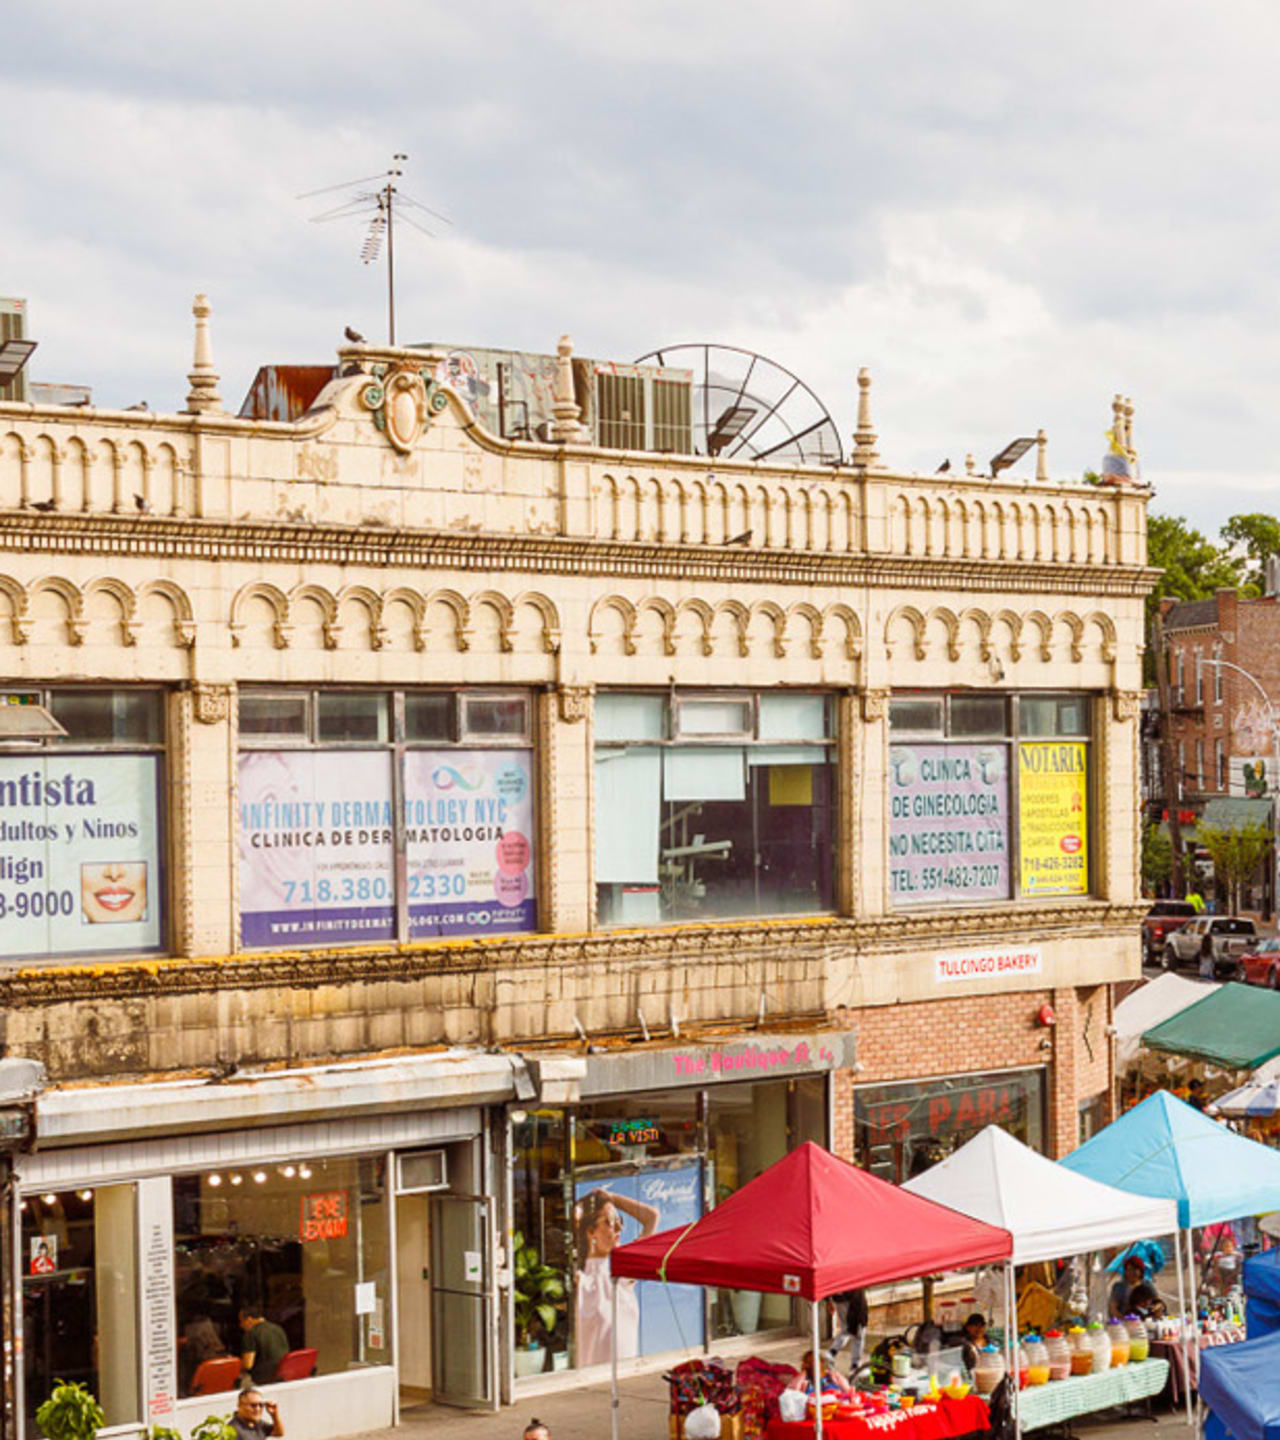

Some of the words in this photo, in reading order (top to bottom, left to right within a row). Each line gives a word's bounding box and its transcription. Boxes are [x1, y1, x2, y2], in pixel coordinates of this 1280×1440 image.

[921, 759, 971, 781] CLINICA
[1021, 746, 1084, 772] NOTARIA
[242, 801, 325, 829] INFINITY
[475, 797, 507, 824] NYC
[892, 795, 910, 818] DE
[65, 823, 75, 844] y
[83, 818, 138, 839] Ninos
[251, 831, 325, 848] CLINICA
[331, 829, 353, 846] DE
[889, 833, 909, 856] NO
[911, 831, 972, 855] NECESITA
[891, 869, 918, 892] TEL:
[940, 957, 994, 977] TULCINGO
[998, 954, 1038, 971] BAKERY
[673, 1055, 705, 1076] The
[711, 1047, 789, 1072] Boutique
